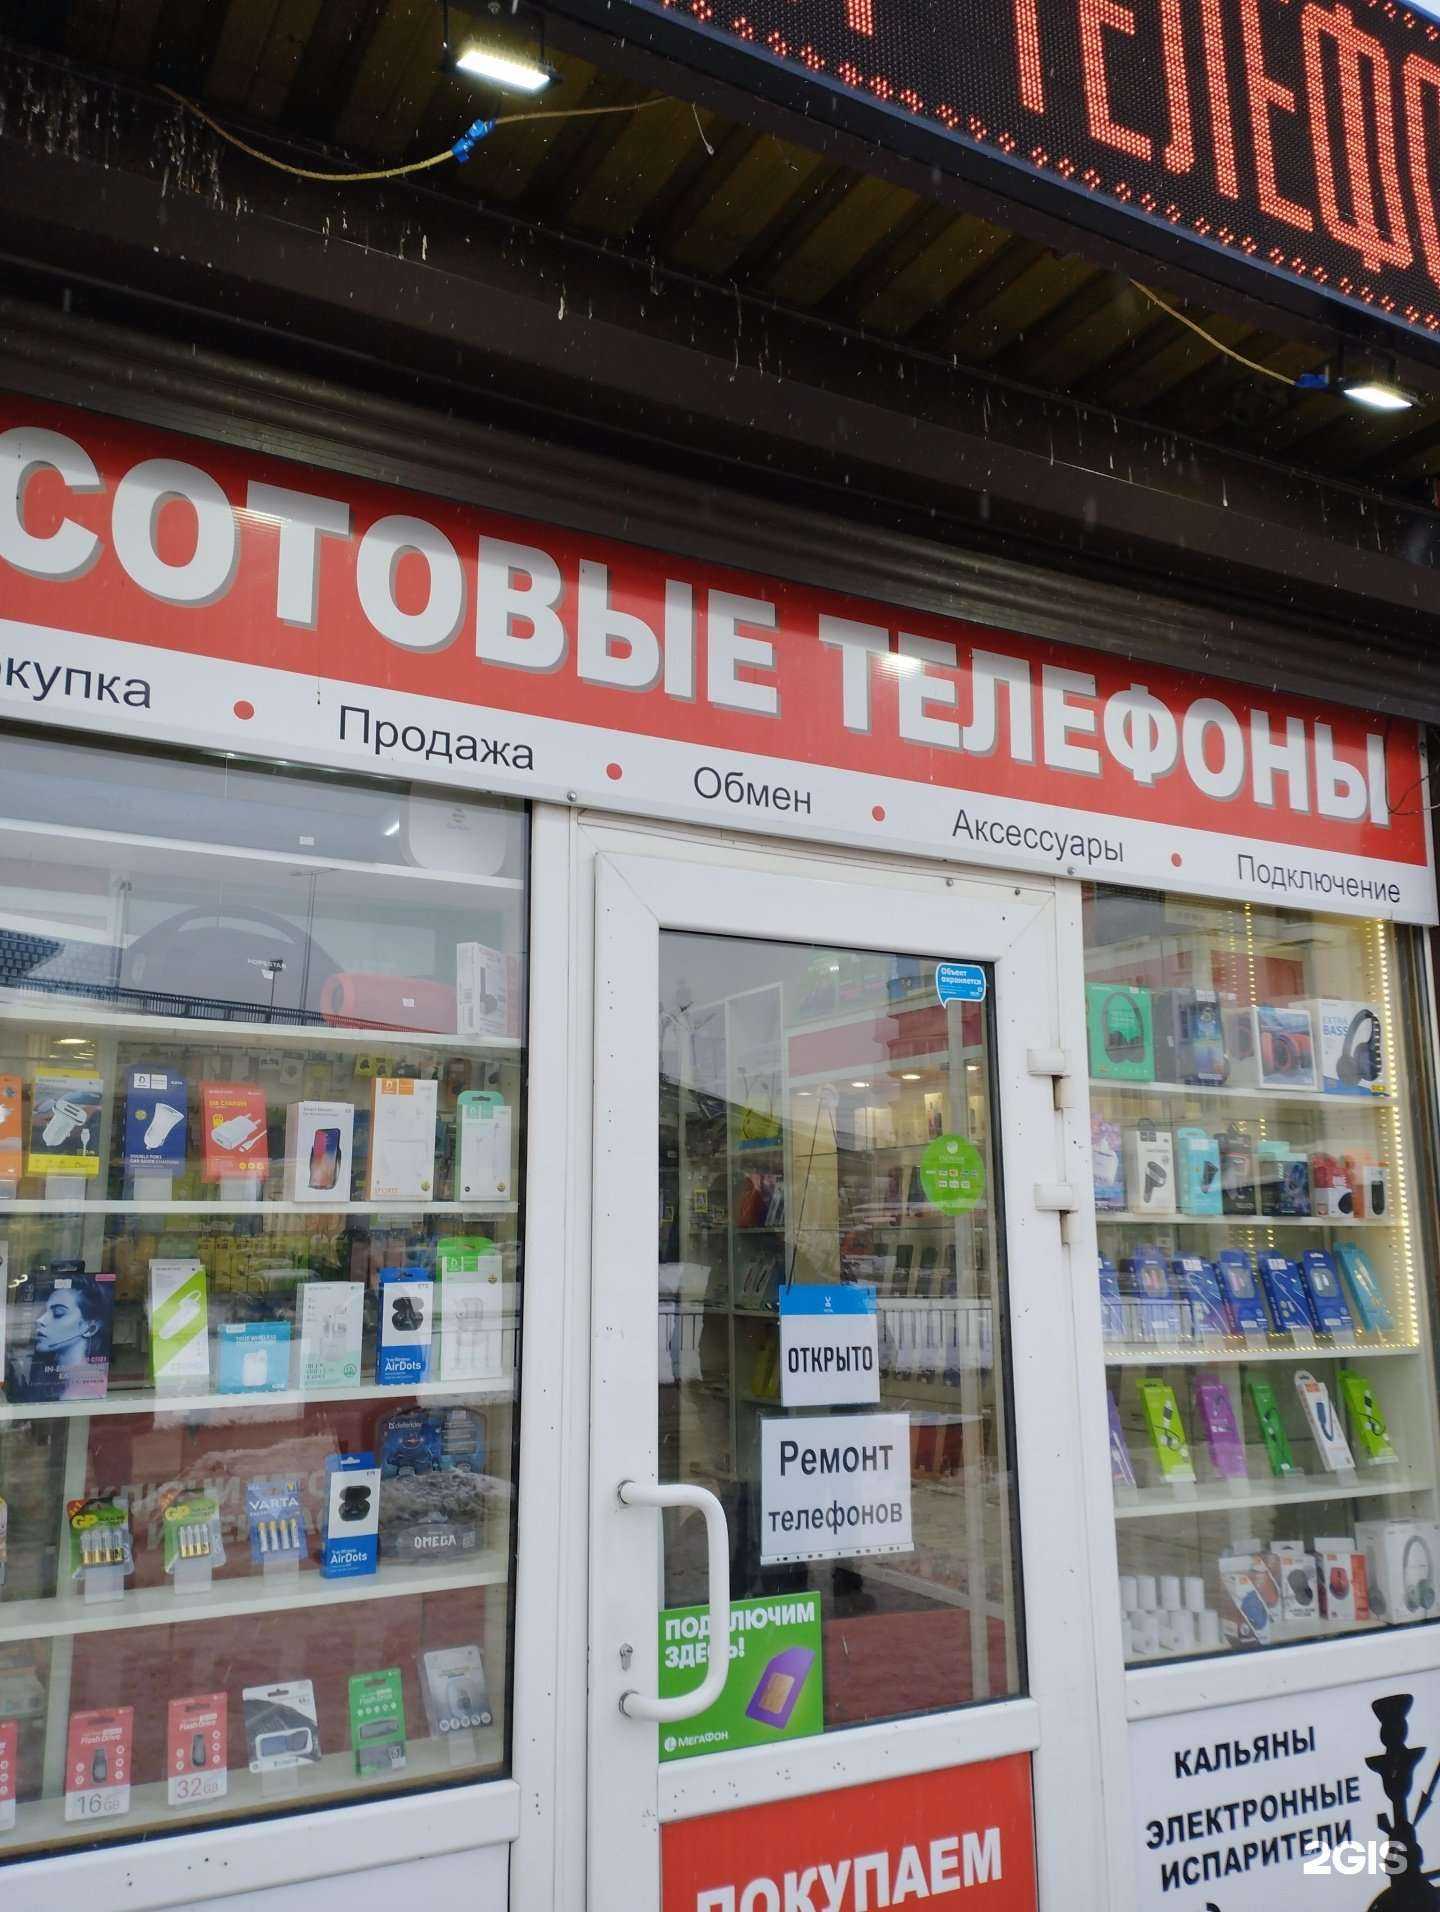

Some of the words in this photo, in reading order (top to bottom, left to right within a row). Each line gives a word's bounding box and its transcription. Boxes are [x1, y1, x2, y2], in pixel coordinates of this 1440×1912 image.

[0, 426, 781, 718] СОТОВЫЕ
[818, 612, 1392, 829] ТЕЛЕФОНЫ
[0, 656, 153, 711] купка
[339, 704, 535, 772] Продажа
[693, 765, 812, 815] Обмен
[952, 809, 1125, 865] Аксессуары
[1236, 853, 1401, 904] Подключение
[384, 1360, 422, 1371] AirDots
[788, 1346, 873, 1373] ОТКРЫТО
[780, 1440, 893, 1476] Ремонт
[71, 1514, 98, 1529] GP
[164, 1504, 190, 1521] GP
[249, 1497, 298, 1511] VARTA
[768, 1500, 903, 1535] телефонов
[330, 1552, 368, 1564] AirDots
[414, 1535, 457, 1549] OMEGA
[665, 1602, 815, 1641] ПОДЛЮЧИМ
[1174, 1726, 1316, 1778] КАЛЬЯНЫ
[77, 1793, 101, 1815] 16
[103, 1799, 120, 1812] GB
[177, 1777, 202, 1799] 32
[203, 1783, 219, 1793] GB
[1146, 1776, 1362, 1849] ЭЛЕКТРОННЫЕ
[1161, 1820, 1352, 1892] ИСПАРИТЕЛИ
